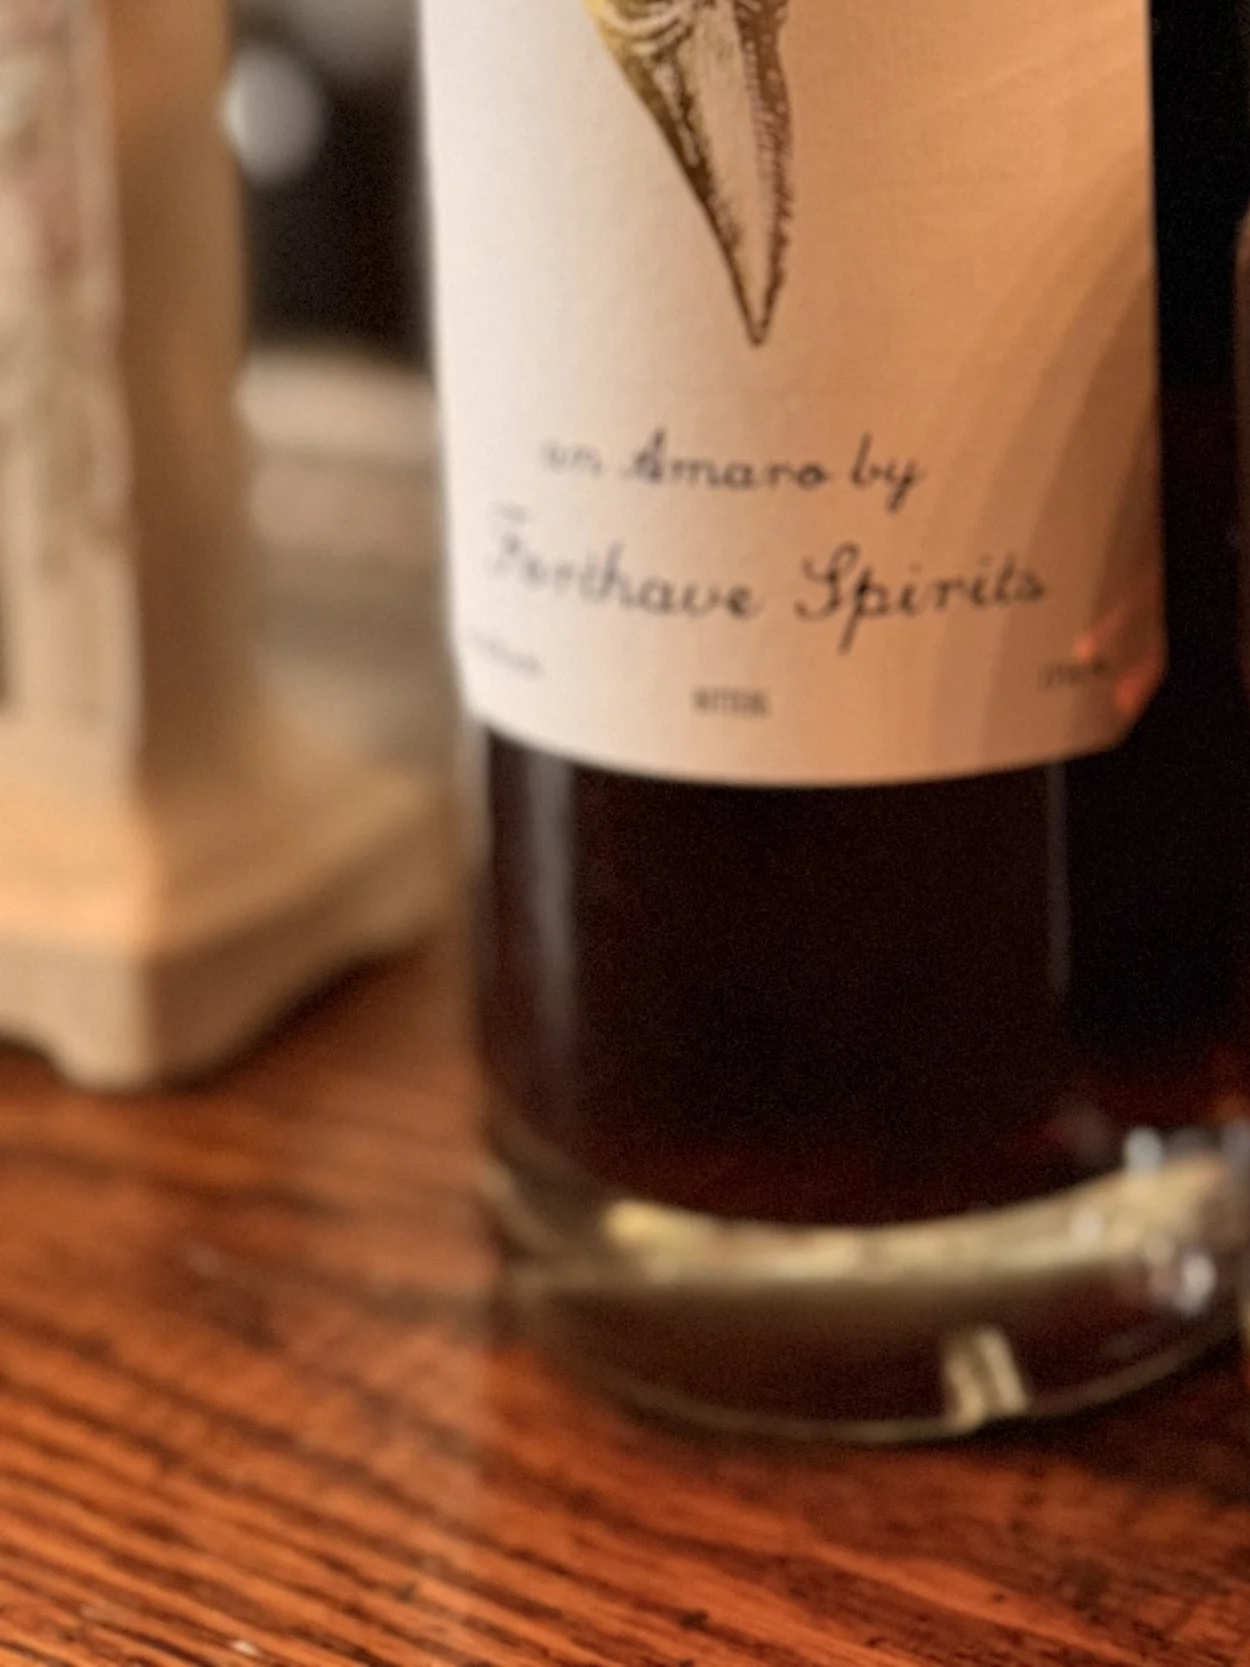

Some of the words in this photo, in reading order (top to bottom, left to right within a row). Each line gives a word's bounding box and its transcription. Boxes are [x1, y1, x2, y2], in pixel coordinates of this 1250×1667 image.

[621, 427, 832, 490] Amaro
[850, 431, 922, 513] by
[794, 541, 1047, 655] Spirits
